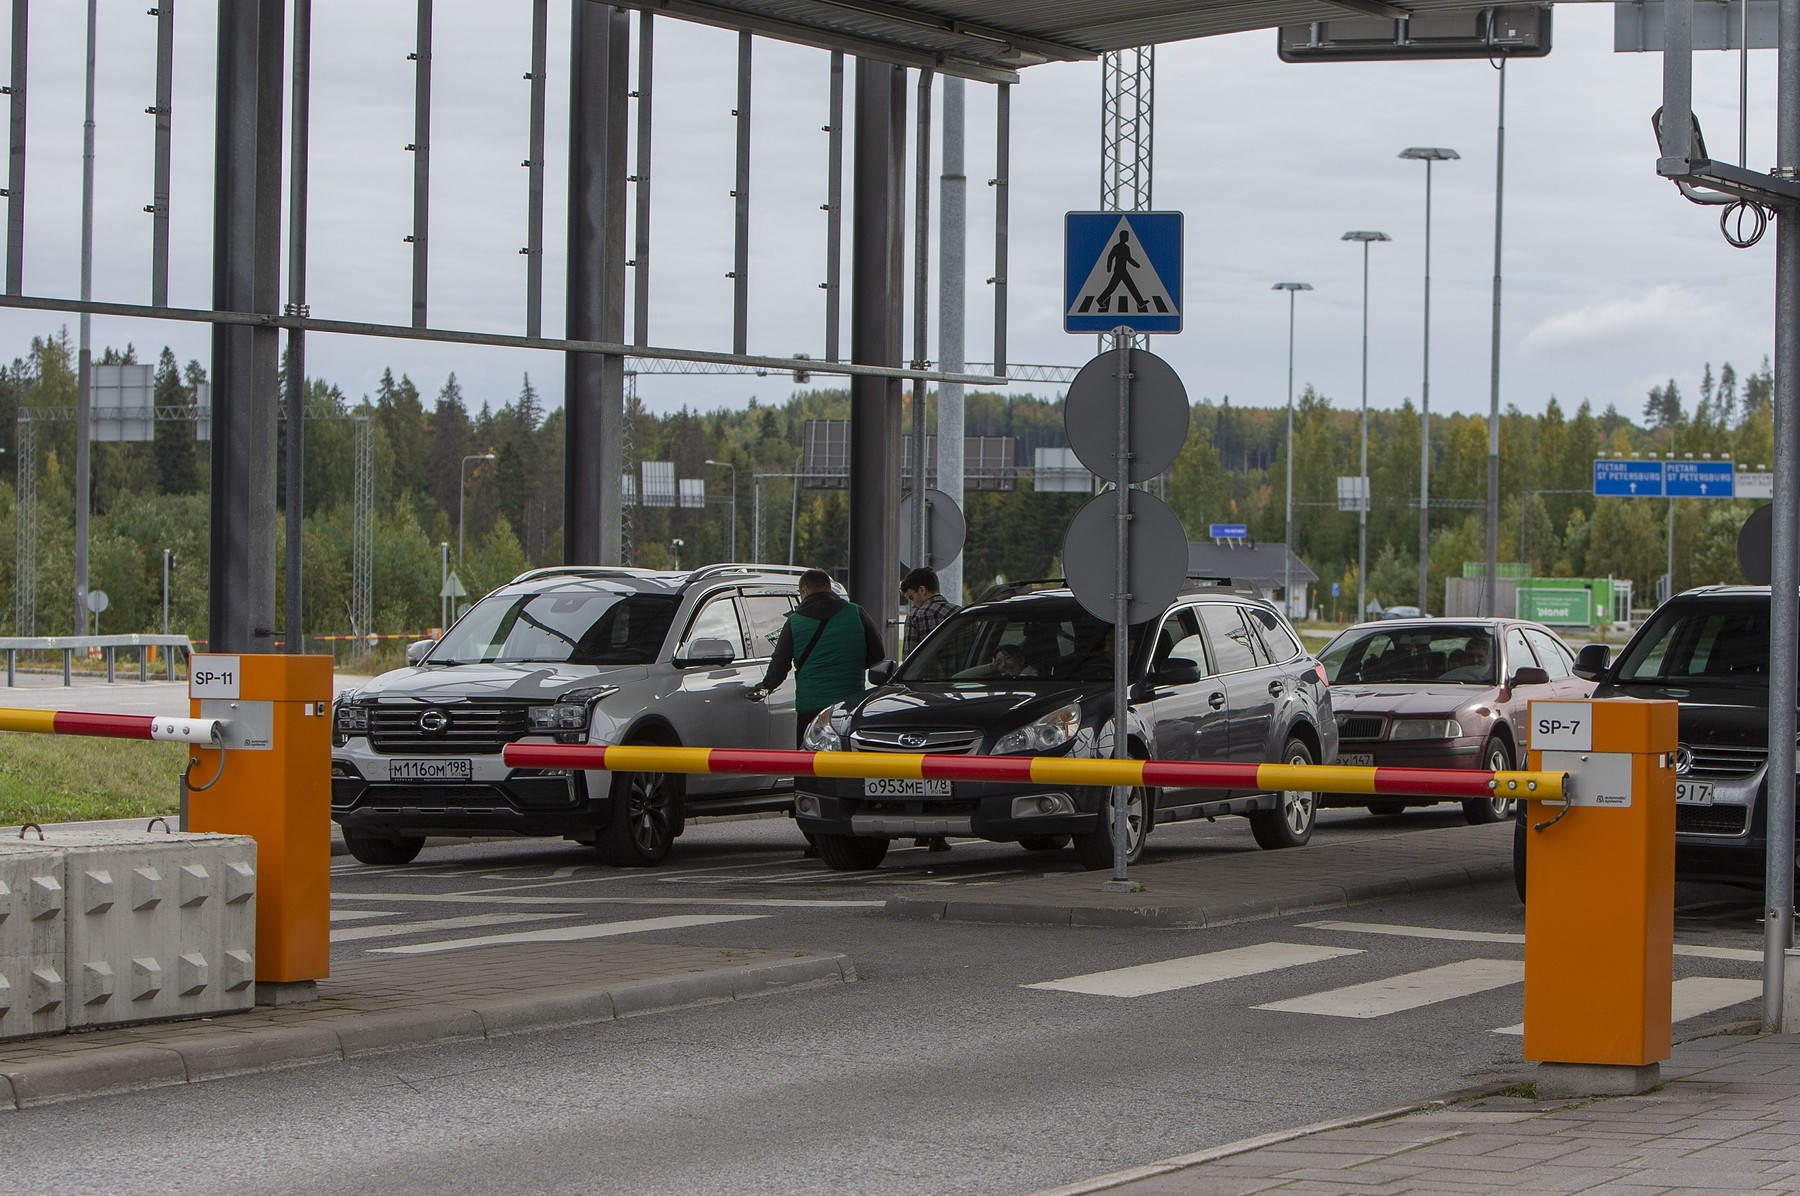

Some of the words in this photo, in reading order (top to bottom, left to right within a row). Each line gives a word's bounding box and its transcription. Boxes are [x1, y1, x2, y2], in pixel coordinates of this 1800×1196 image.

[1597, 463, 1627, 472] PIETARI
[1667, 464, 1698, 473] PIETARI
[1597, 472, 1607, 481] ST
[1609, 472, 1661, 481] PETERSBURG
[1667, 473, 1677, 482] ST
[1679, 473, 1731, 482] PETERSBURG
[1537, 606, 1569, 617] planet
[195, 671, 233, 686] SP-11
[1538, 719, 1581, 735] SP-7
[447, 761, 467, 773] 198
